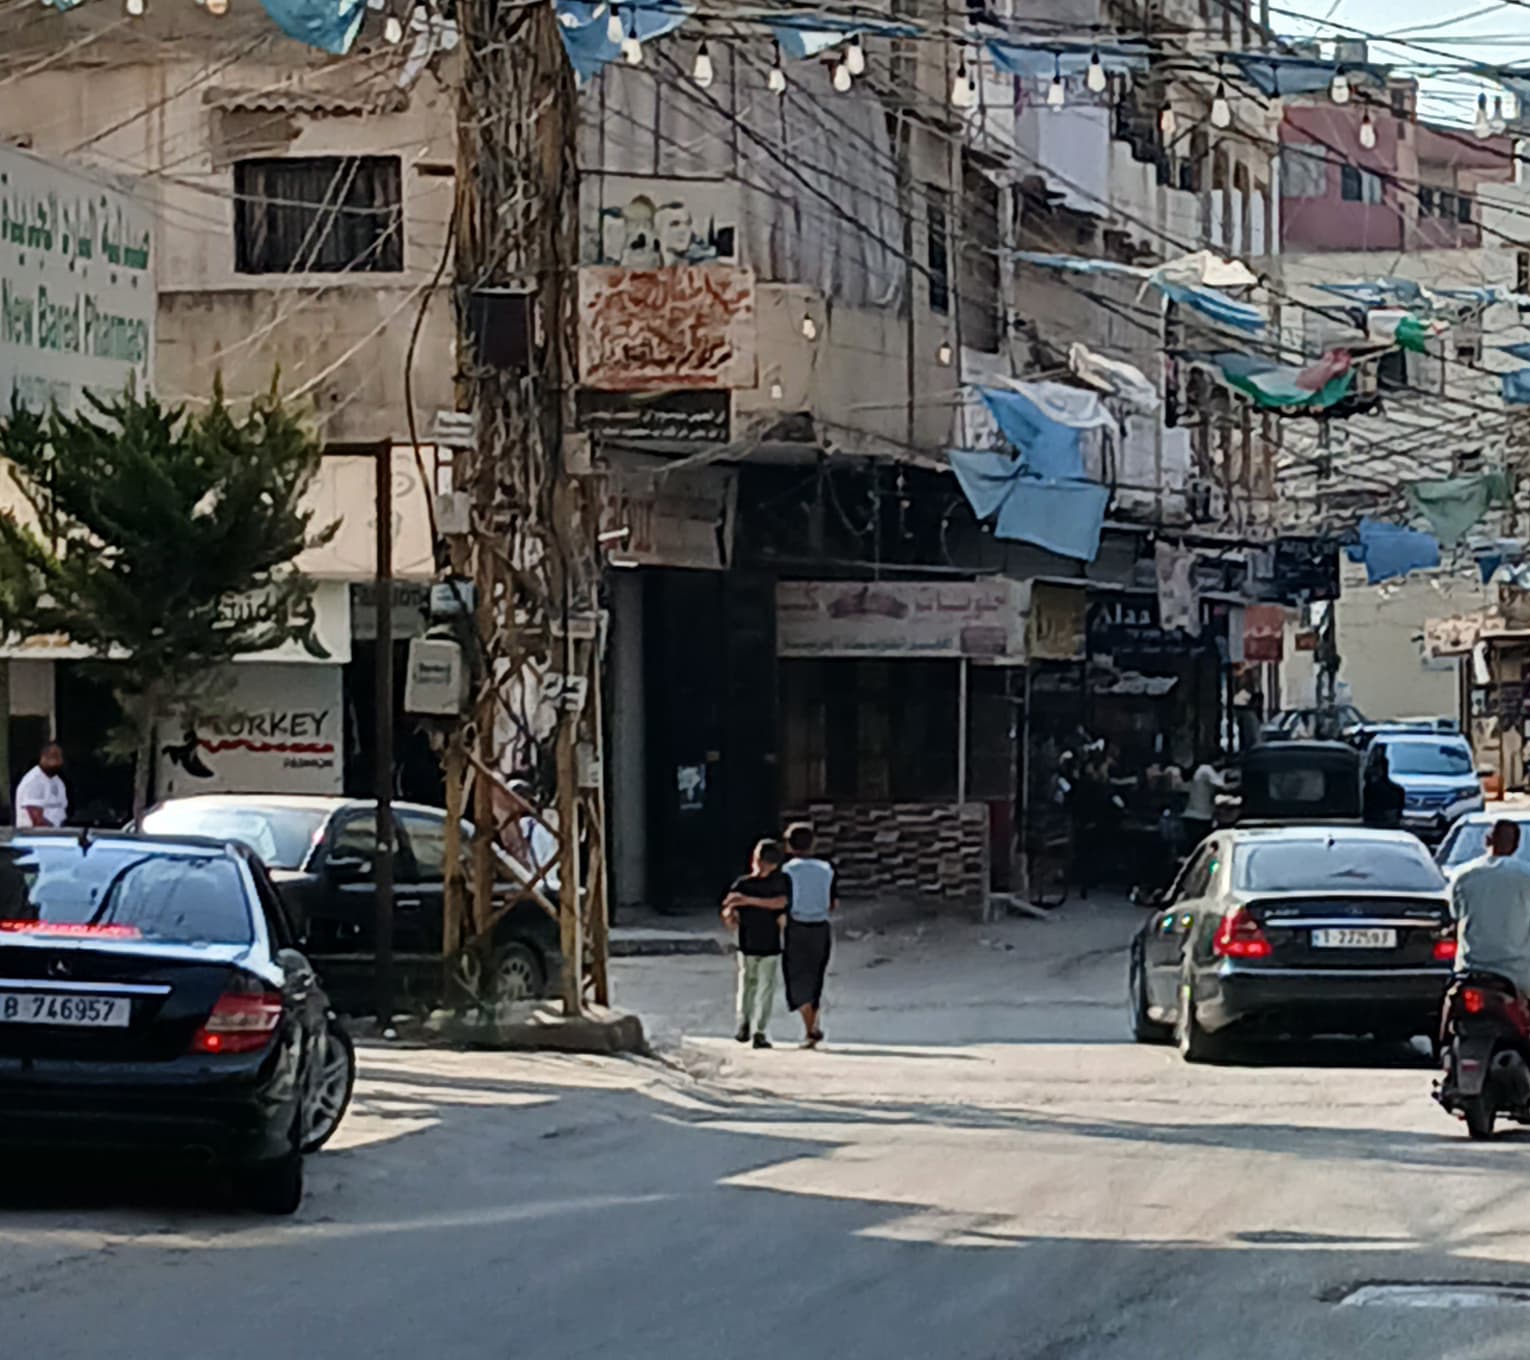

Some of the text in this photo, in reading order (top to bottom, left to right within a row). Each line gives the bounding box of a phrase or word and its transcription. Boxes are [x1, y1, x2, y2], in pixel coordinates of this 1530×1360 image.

[1, 277, 148, 379] New Bared Pharmacy
[4, 996, 115, 1022] B 746957
